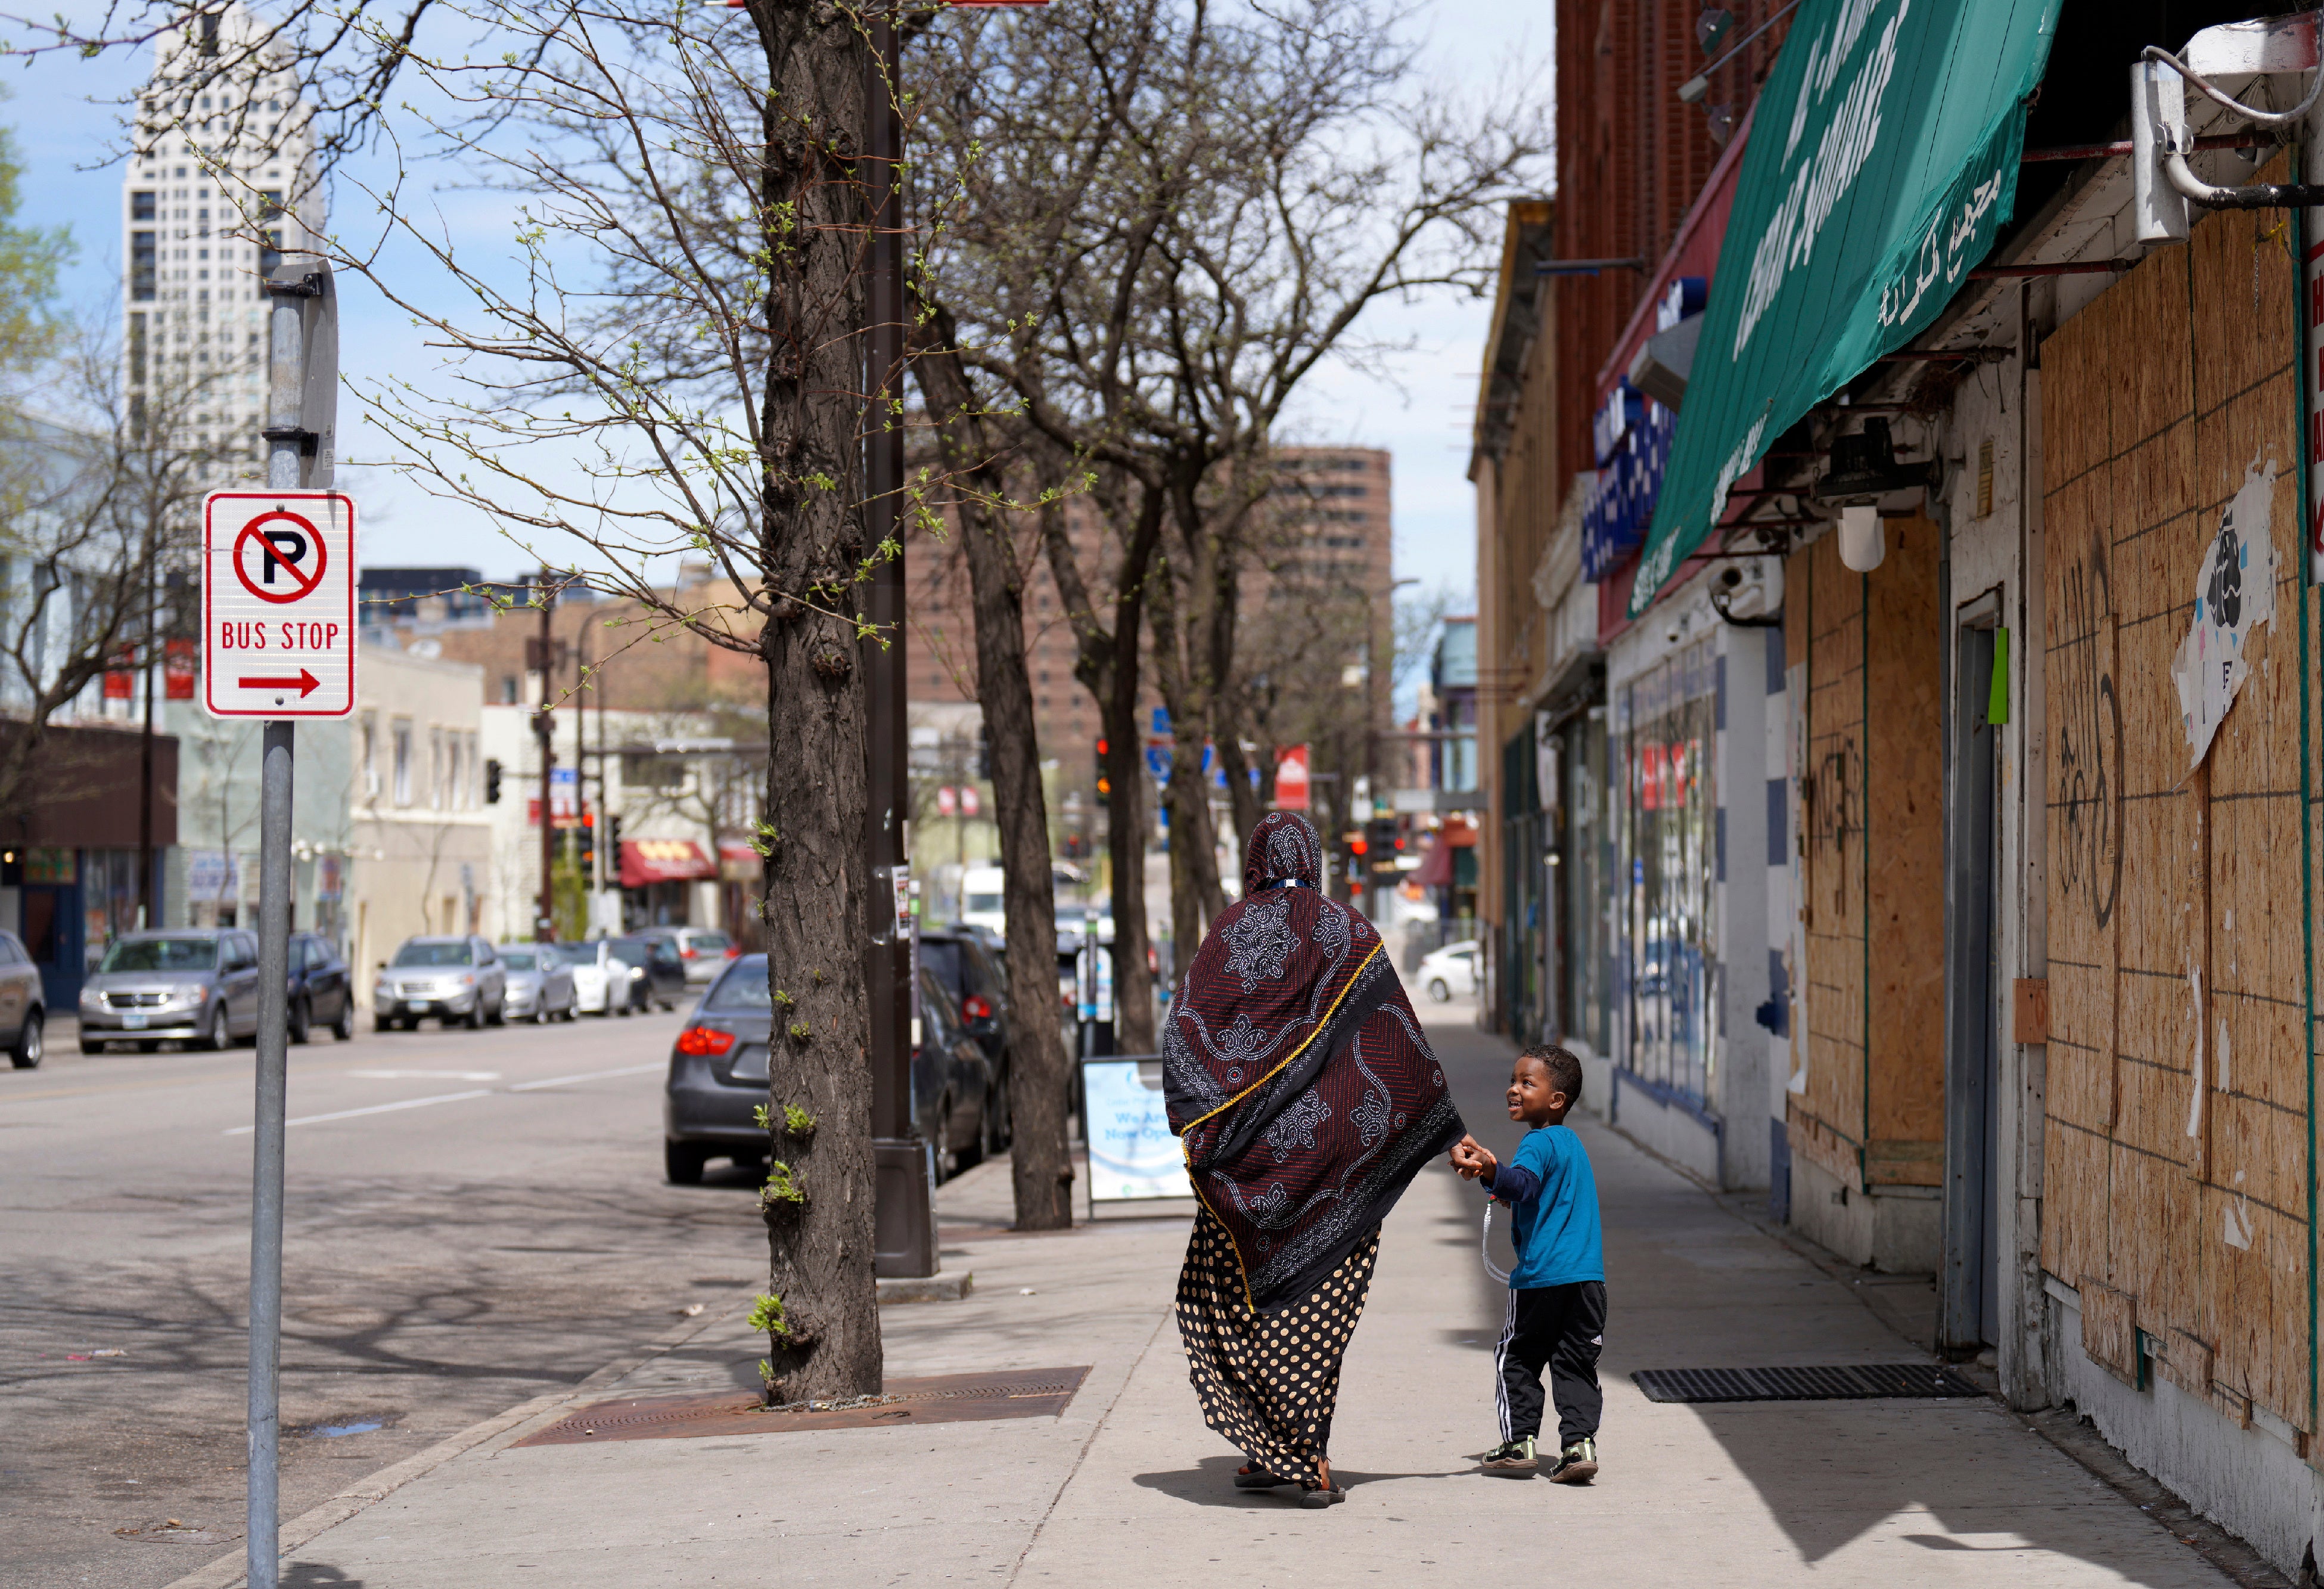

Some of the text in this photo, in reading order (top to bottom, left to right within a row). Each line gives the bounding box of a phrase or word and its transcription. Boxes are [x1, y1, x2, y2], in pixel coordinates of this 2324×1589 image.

[1789, 0, 1910, 271] SQUARE
[264, 531, 306, 584] P
[222, 622, 338, 649] BUS STOP
[1116, 1113, 1139, 1124] We
